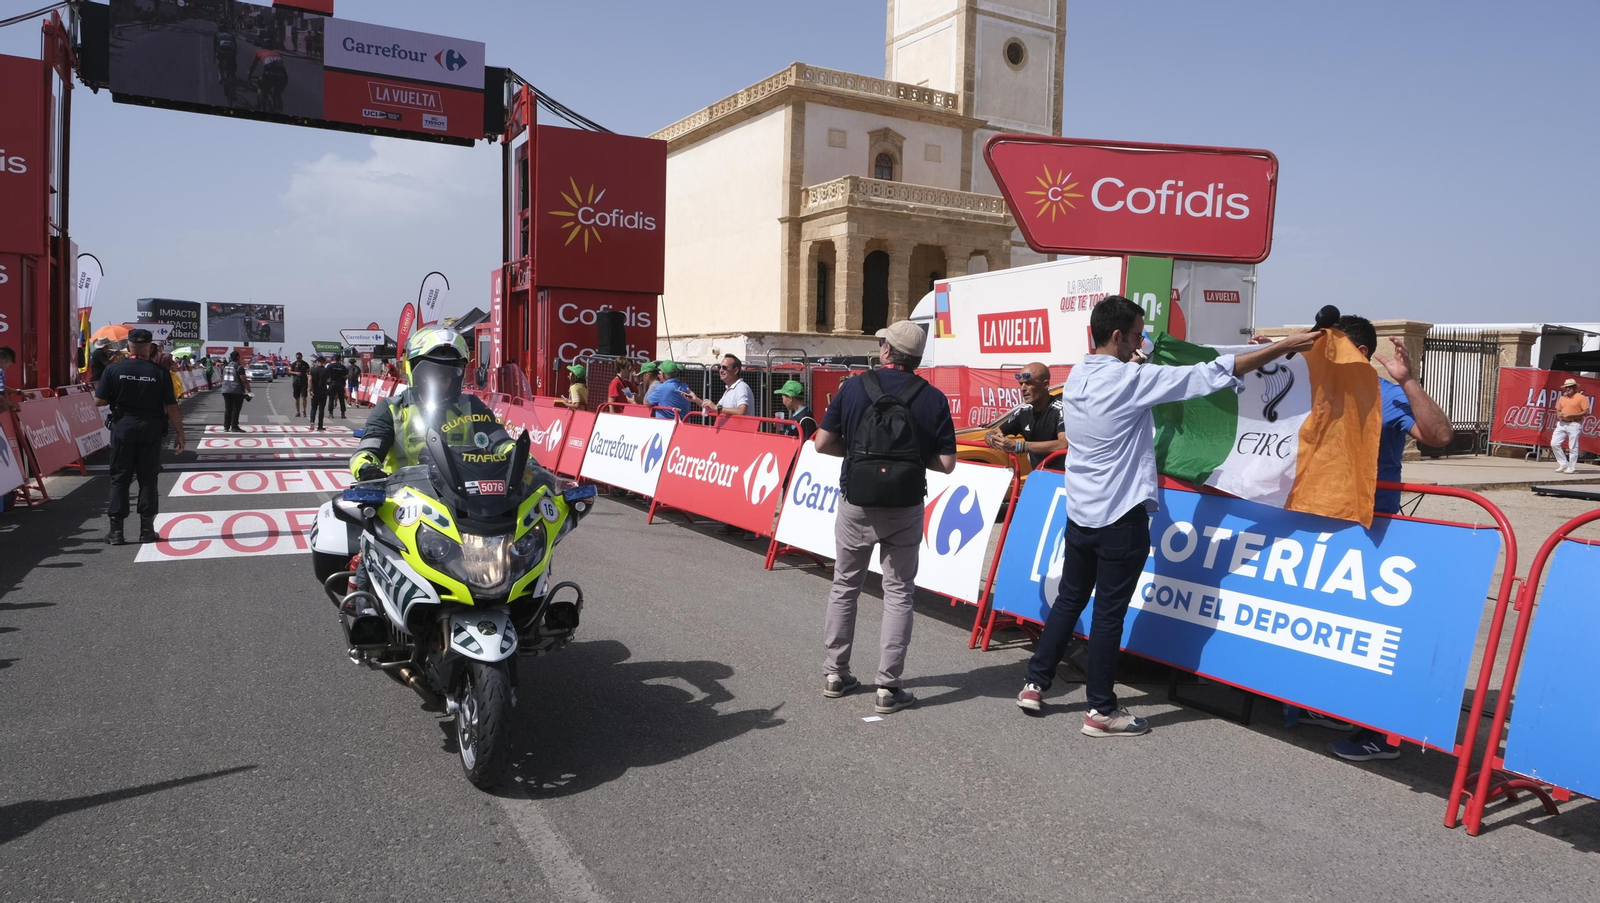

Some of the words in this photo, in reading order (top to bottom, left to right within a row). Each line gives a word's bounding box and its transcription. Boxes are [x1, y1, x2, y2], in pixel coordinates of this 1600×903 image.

[342, 37, 428, 63] Carrefour
[376, 87, 390, 101] LA
[392, 89, 436, 108] VUELTA
[1091, 177, 1250, 220] Cofidis
[577, 206, 657, 231] Cofidis
[1216, 294, 1238, 302] VUELTA
[983, 320, 997, 347] LA
[999, 317, 1045, 346] VUELTA
[119, 374, 157, 383] POLICIA
[1526, 388, 1547, 408] LA
[441, 413, 492, 433] GUARDIA
[1504, 406, 1546, 430] QUE
[204, 437, 360, 448] COFIDIS
[590, 431, 639, 462] Carrefour
[462, 452, 507, 463] TRAFICO
[666, 446, 740, 488] Carrefour
[481, 482, 504, 492] 5076
[398, 505, 418, 519] 211
[543, 504, 554, 517] 16
[1149, 517, 1417, 607] OTERÍAS
[1141, 583, 1193, 612] CON
[1199, 594, 1225, 621] EL
[1234, 603, 1373, 658] DEPORTE
